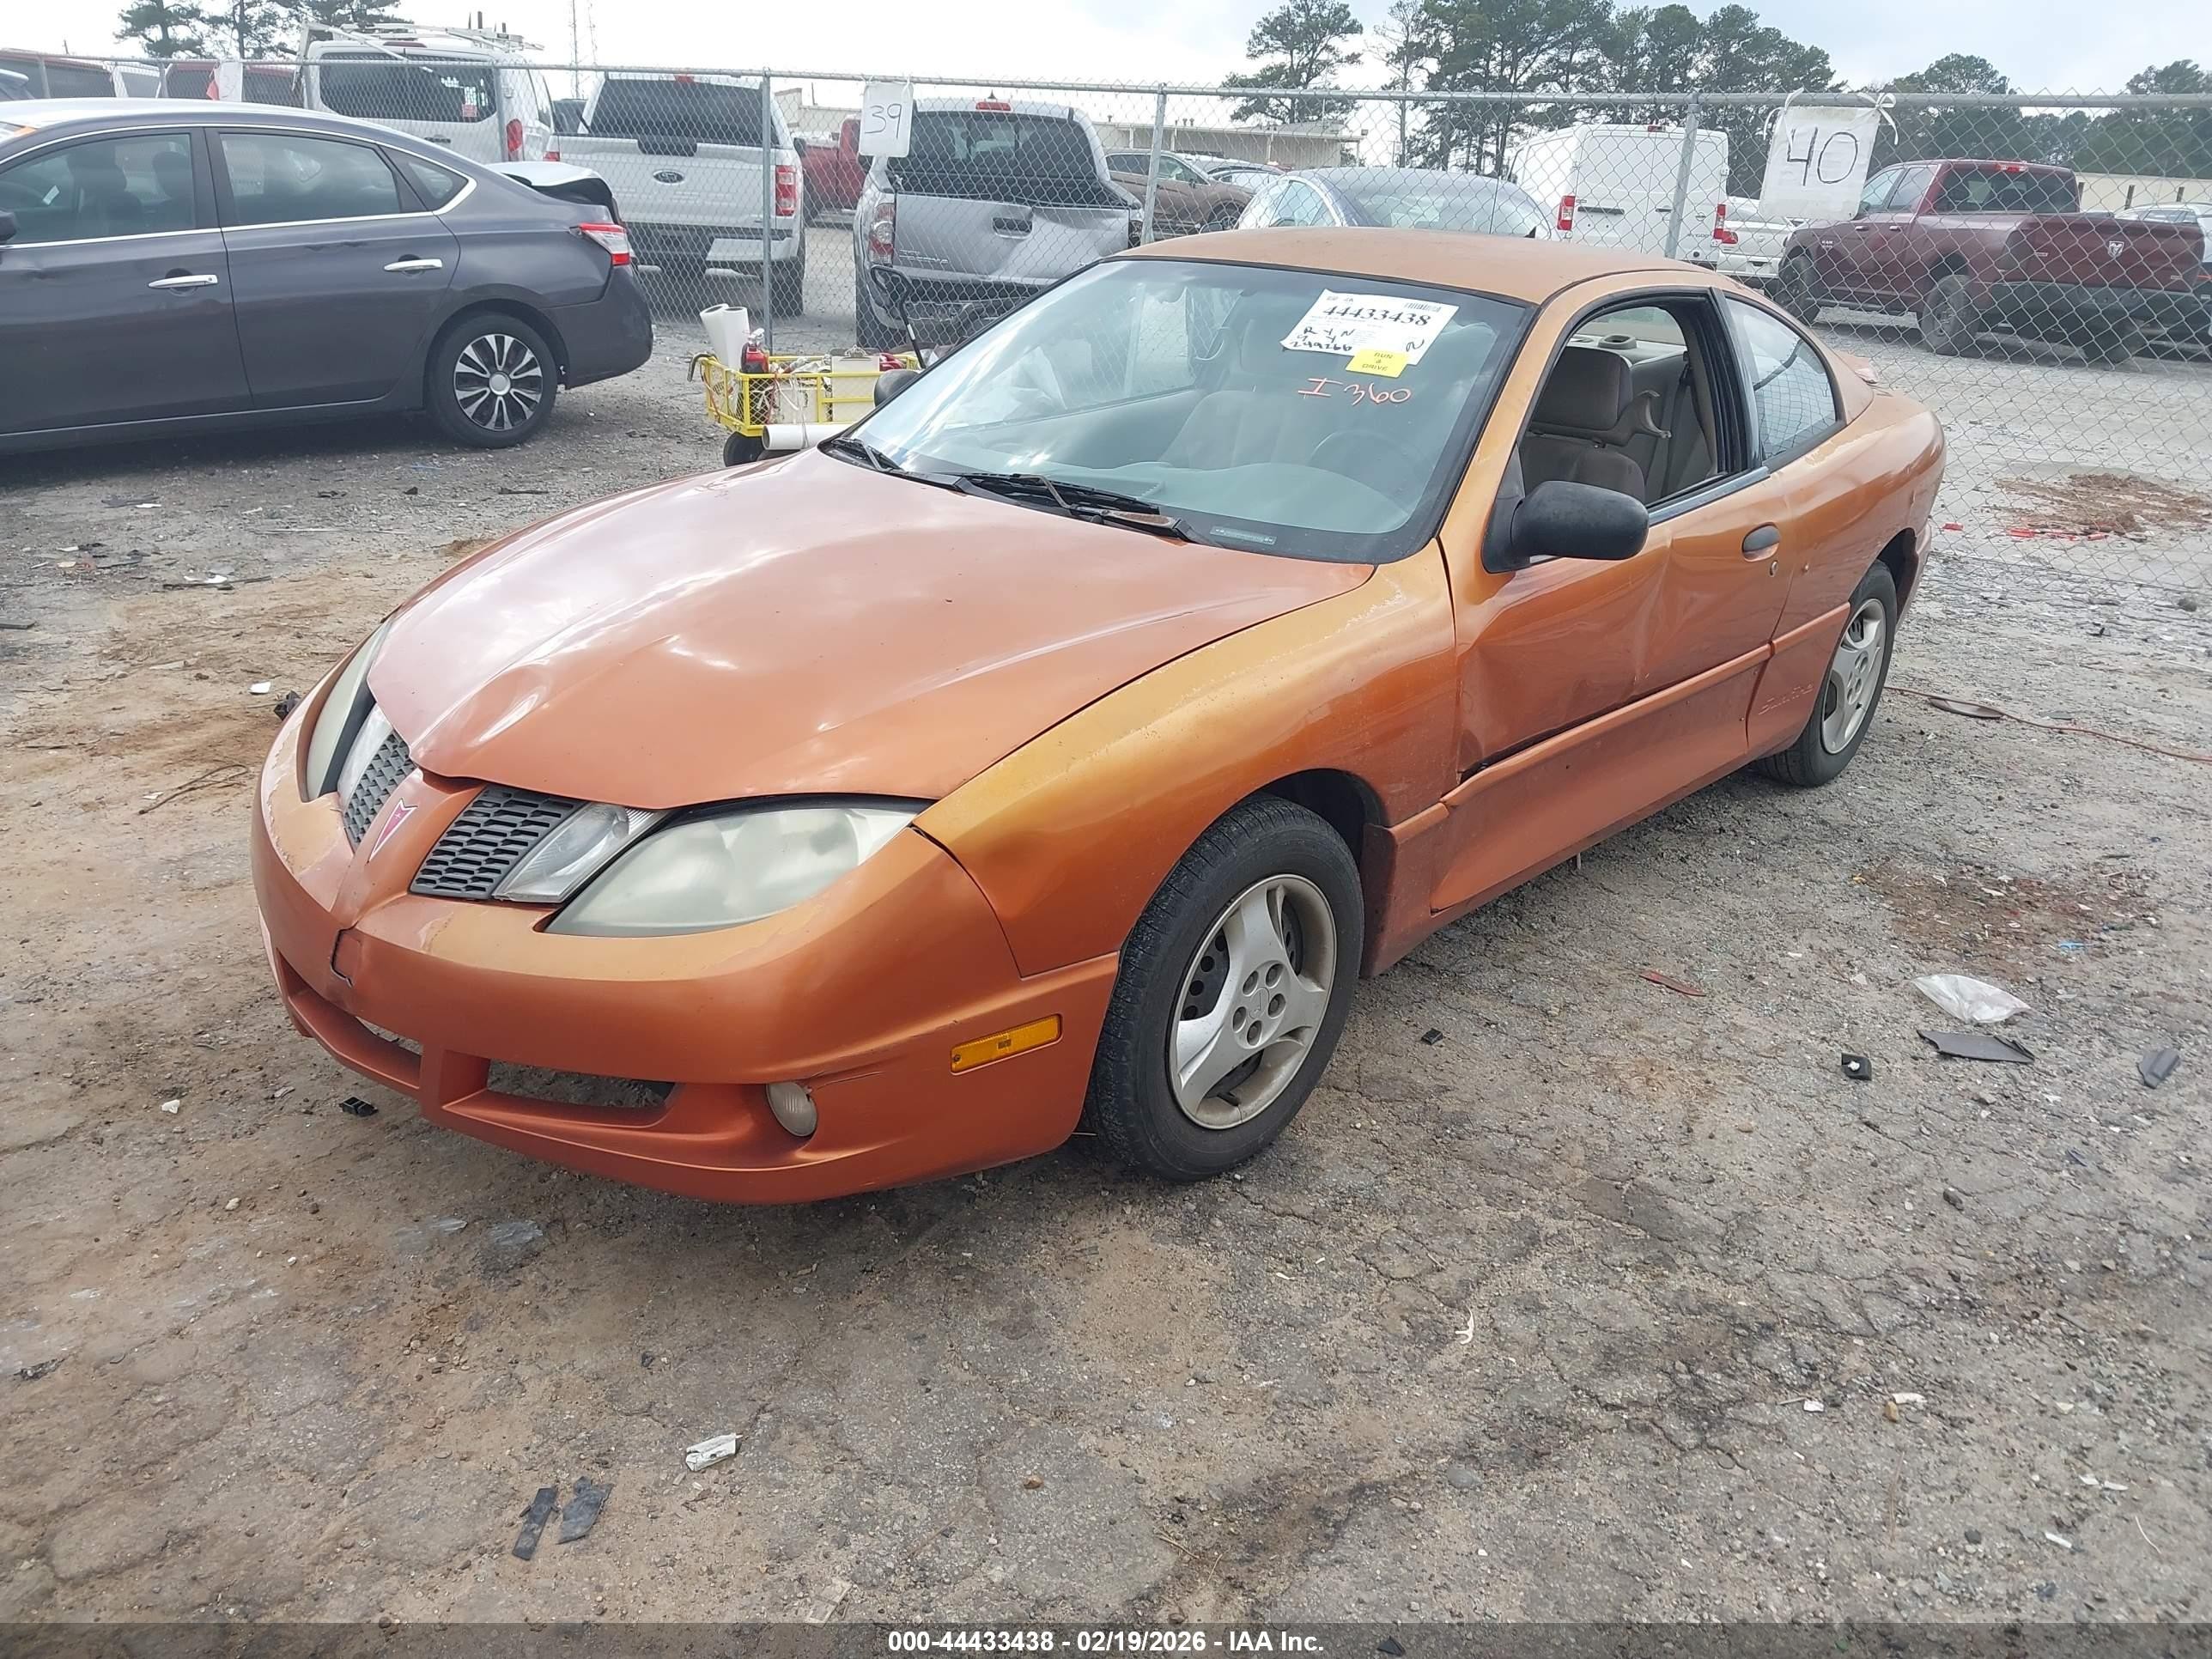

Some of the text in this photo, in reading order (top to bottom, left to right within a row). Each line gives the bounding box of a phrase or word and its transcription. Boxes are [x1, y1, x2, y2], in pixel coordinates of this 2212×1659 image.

[864, 103, 902, 140] 39
[1787, 127, 1858, 186] 40
[1323, 305, 1431, 326] 44433438
[1344, 382, 1412, 407] 360
